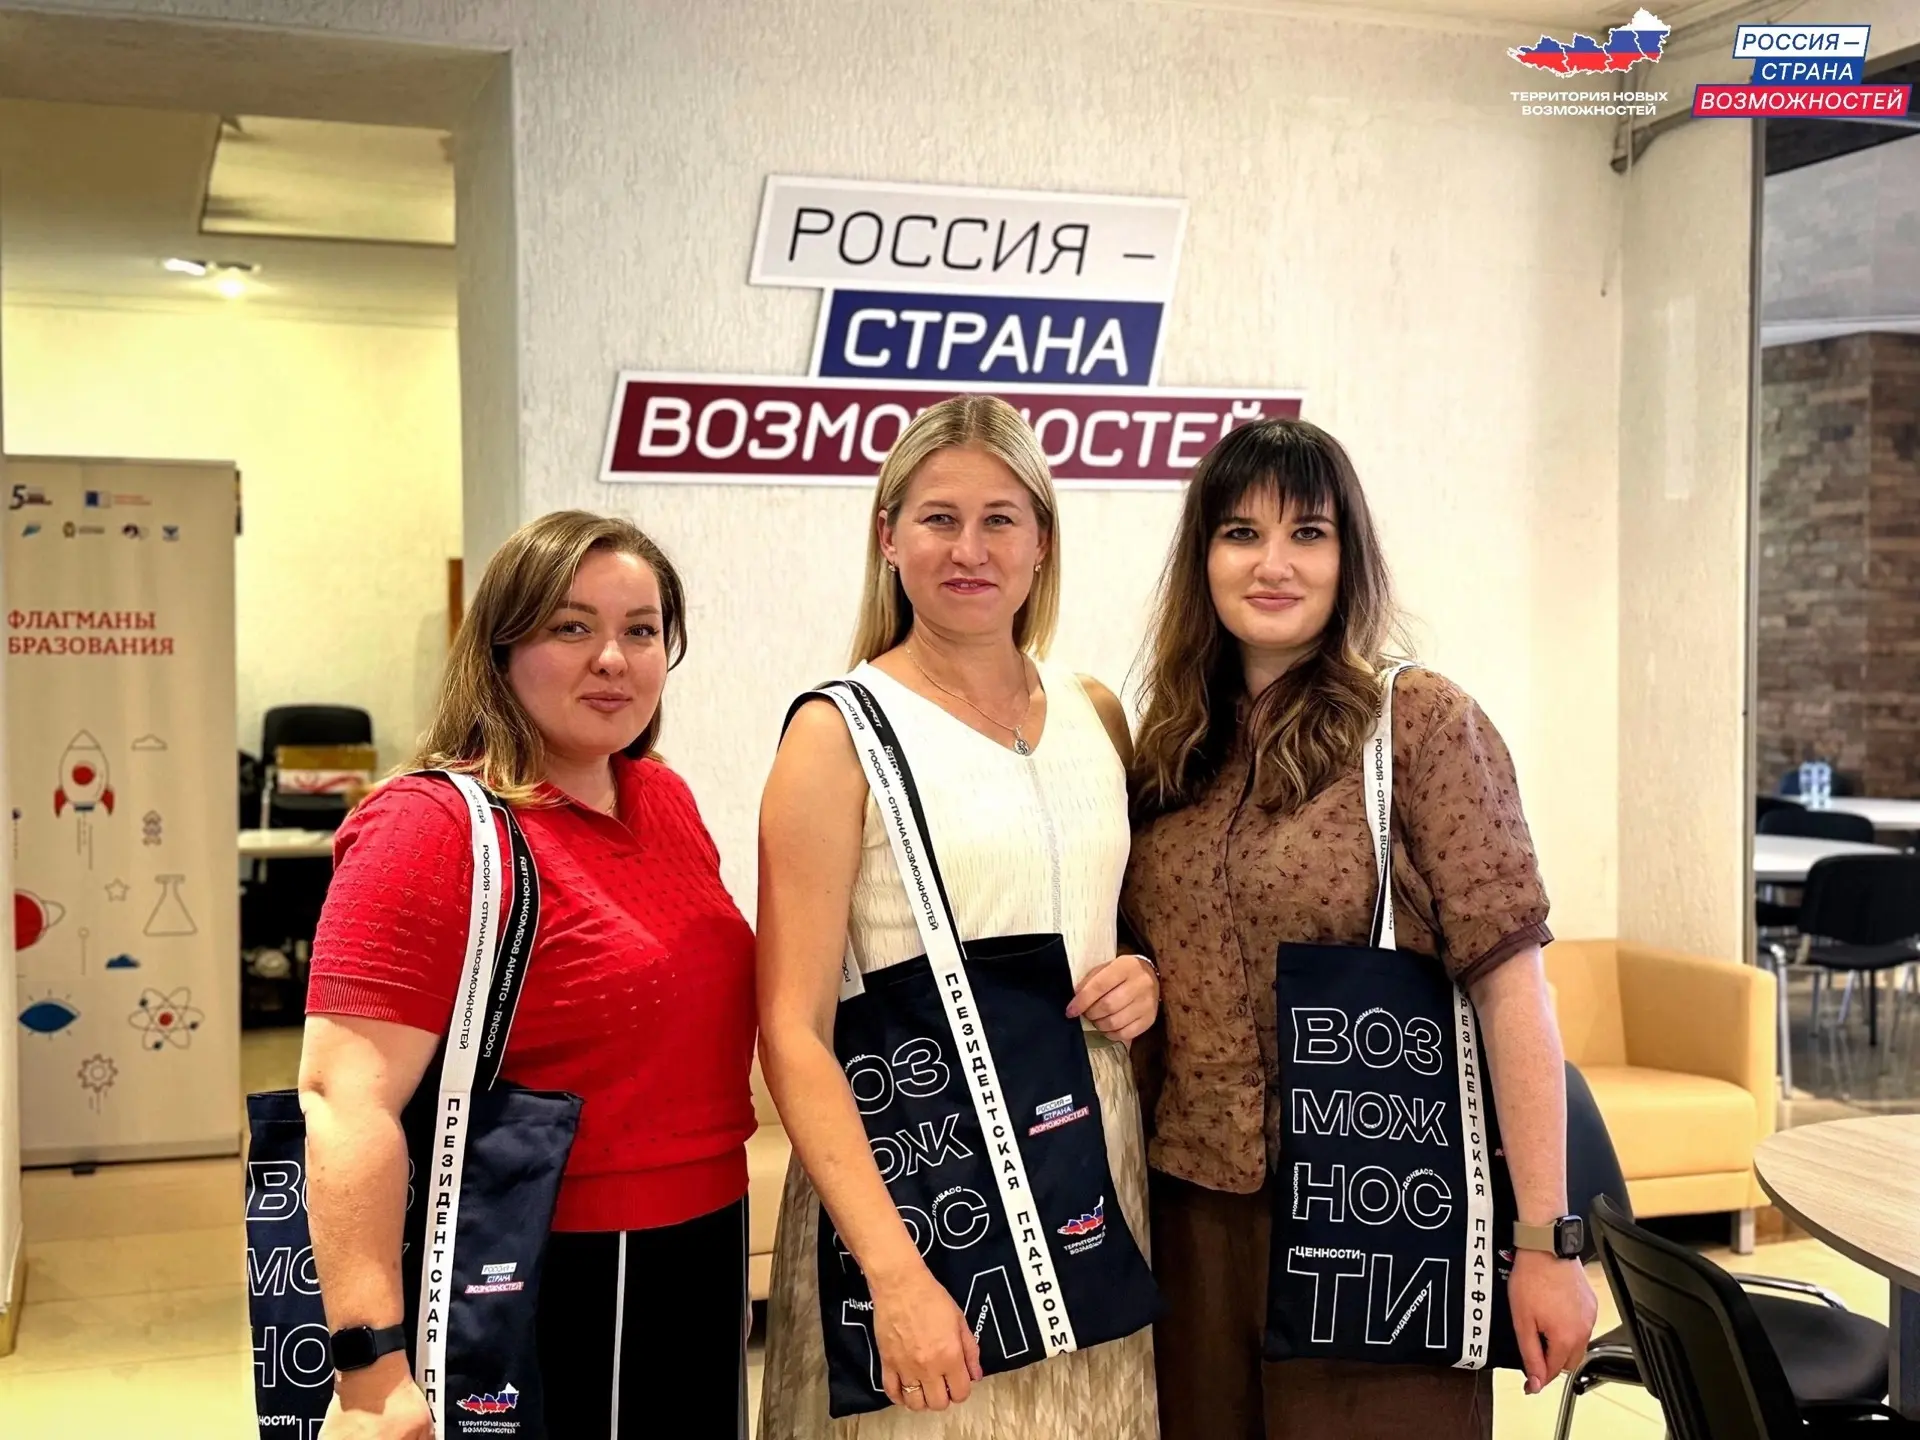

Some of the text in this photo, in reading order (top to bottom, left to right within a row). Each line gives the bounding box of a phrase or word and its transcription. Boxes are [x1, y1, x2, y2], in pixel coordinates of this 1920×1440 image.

[788, 206, 1090, 277] РОССИЯ
[843, 306, 1129, 378] СТРАНА
[637, 396, 1265, 470] ВОЗМООСТЕ
[7, 609, 156, 630] ФЛАГМАНЫ
[8, 636, 174, 656] БРАЗОВАНИЯ
[1375, 738, 1384, 781] РОССИЯ
[867, 748, 890, 789] РОССИЯ
[887, 795, 907, 838] СТРАНА
[902, 839, 939, 932] ВОЗМОЖНОСТЕЙ
[1377, 789, 1387, 833] СТРАНА
[482, 844, 491, 891] РОССИЯ
[478, 901, 489, 948] СТРАНА
[459, 948, 483, 1050] ВОЗМОЖНОСТЕЙ
[1291, 1007, 1443, 1076] ВОЗ
[846, 1037, 950, 1115] ОЗ
[944, 972, 1019, 1190] ПРЕЗИДЕНТСКАЯ
[1460, 998, 1485, 1198] РЕЗИДЕНТСКАЯ
[868, 1113, 974, 1184] ОЖ
[1292, 1088, 1449, 1147] МОЖ
[1292, 1162, 1452, 1230] НОС
[1403, 1168, 1434, 1190] ДОНБАСС
[425, 1097, 461, 1344] ПРЕЗИДЕНТСКАЯ
[1295, 1246, 1361, 1260] ЦЕННОСТИ
[1287, 1248, 1450, 1349] ТИ
[1390, 1288, 1428, 1341] ЛИДЕРСТВО
[258, 1415, 296, 1427] НОСТИ
